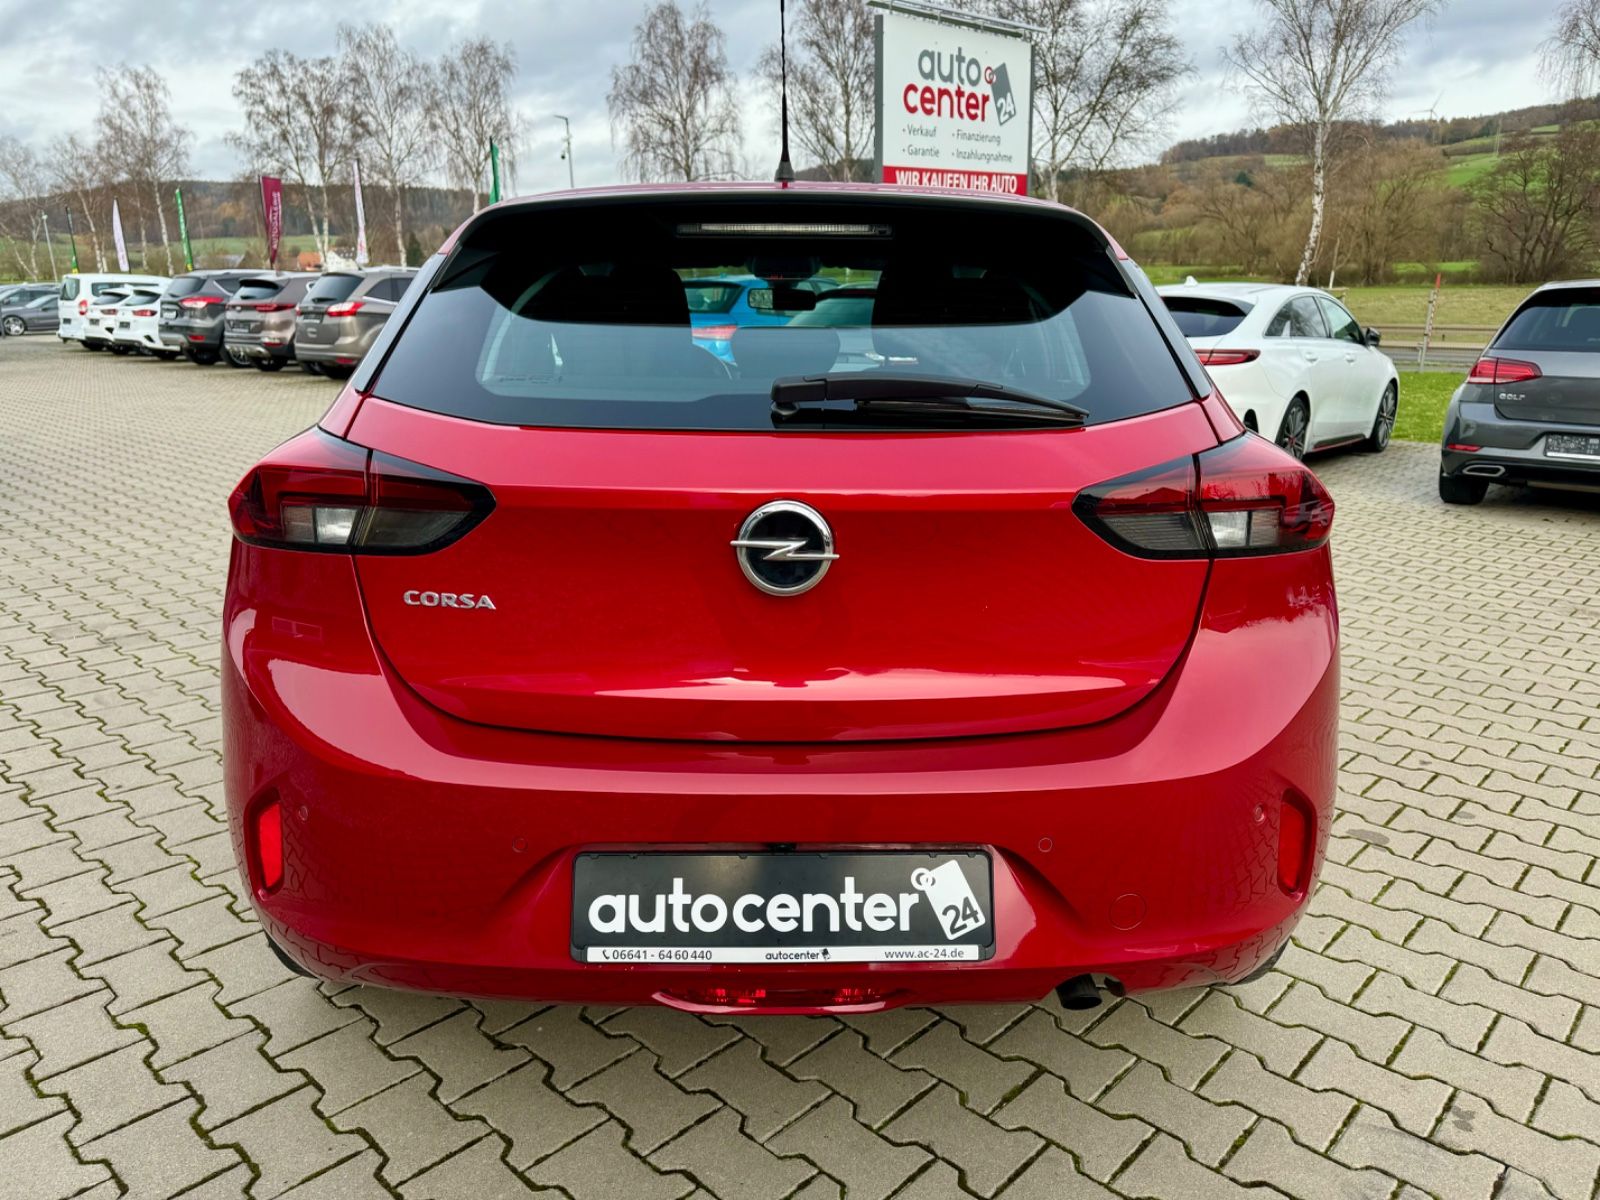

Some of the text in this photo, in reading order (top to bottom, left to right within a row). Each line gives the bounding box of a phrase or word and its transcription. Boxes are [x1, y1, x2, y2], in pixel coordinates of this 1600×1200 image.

[918, 47, 981, 86] auto
[903, 83, 990, 122] center
[997, 93, 1015, 122] 24
[907, 124, 937, 138] Verkauf
[956, 129, 1001, 146] Finanzierung
[907, 144, 940, 158] Garantie
[956, 149, 1013, 164] Inzahlungnahme
[895, 170, 1017, 193] WIR KAUFEN IHR AUTO
[403, 589, 497, 610] CORSA
[942, 896, 982, 935] 24
[765, 949, 820, 961] autocenter
[884, 948, 965, 959] www.ac-24.de
